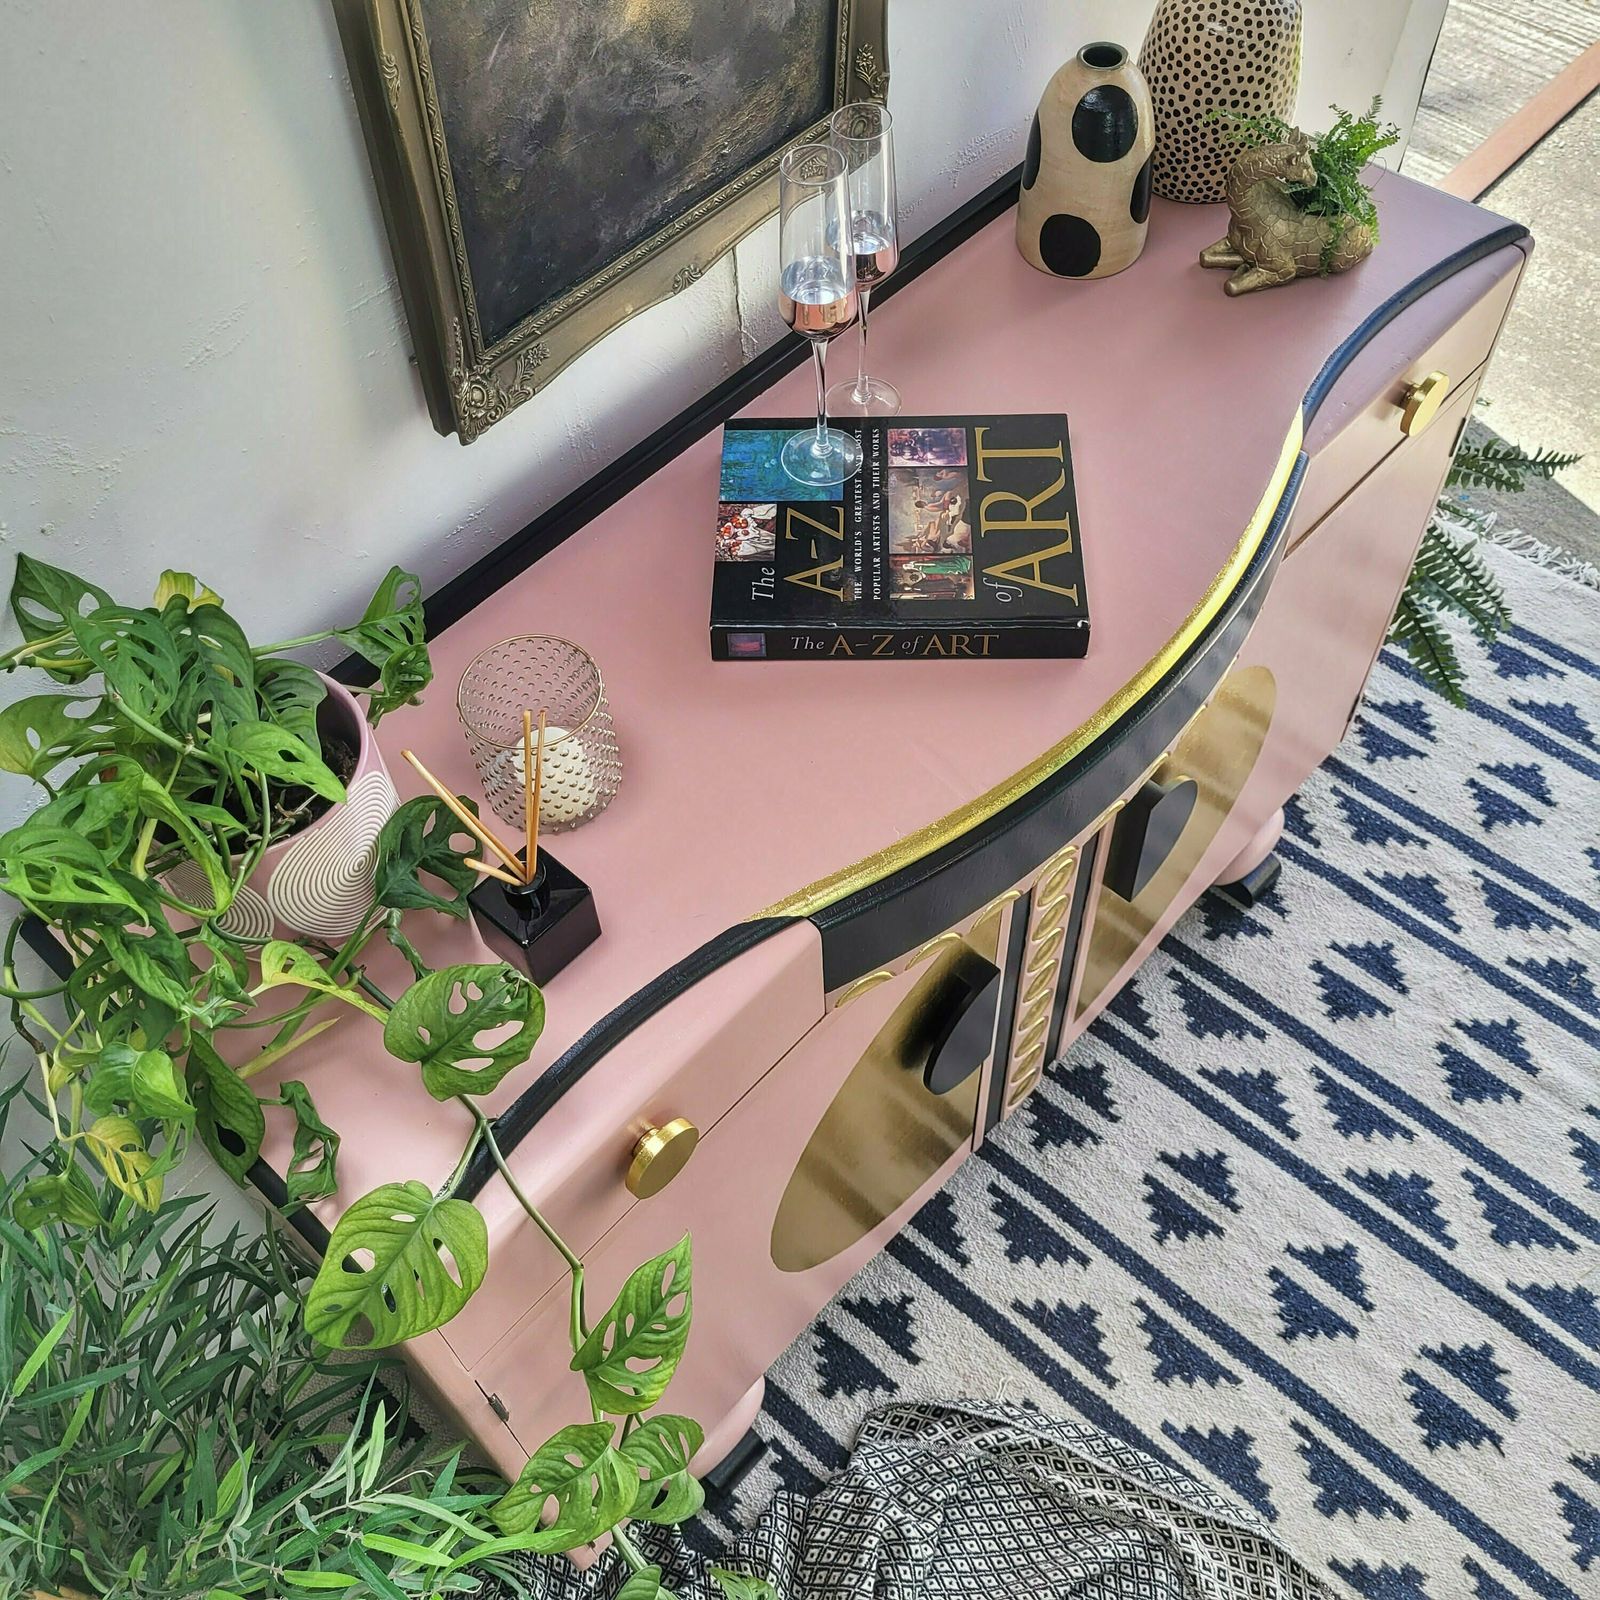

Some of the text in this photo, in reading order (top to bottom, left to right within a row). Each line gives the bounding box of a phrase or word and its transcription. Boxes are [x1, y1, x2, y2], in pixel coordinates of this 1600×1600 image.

[854, 478, 863, 523] GREATEST
[872, 428, 881, 601] POPULAR ARTISTS AND THEIR WORKS
[974, 427, 1079, 607] of ART
[751, 505, 845, 603] The A-Z
[854, 531, 863, 573] WORLD'S
[854, 582, 863, 601] THE
[788, 633, 1000, 656] The A-Z of ART
